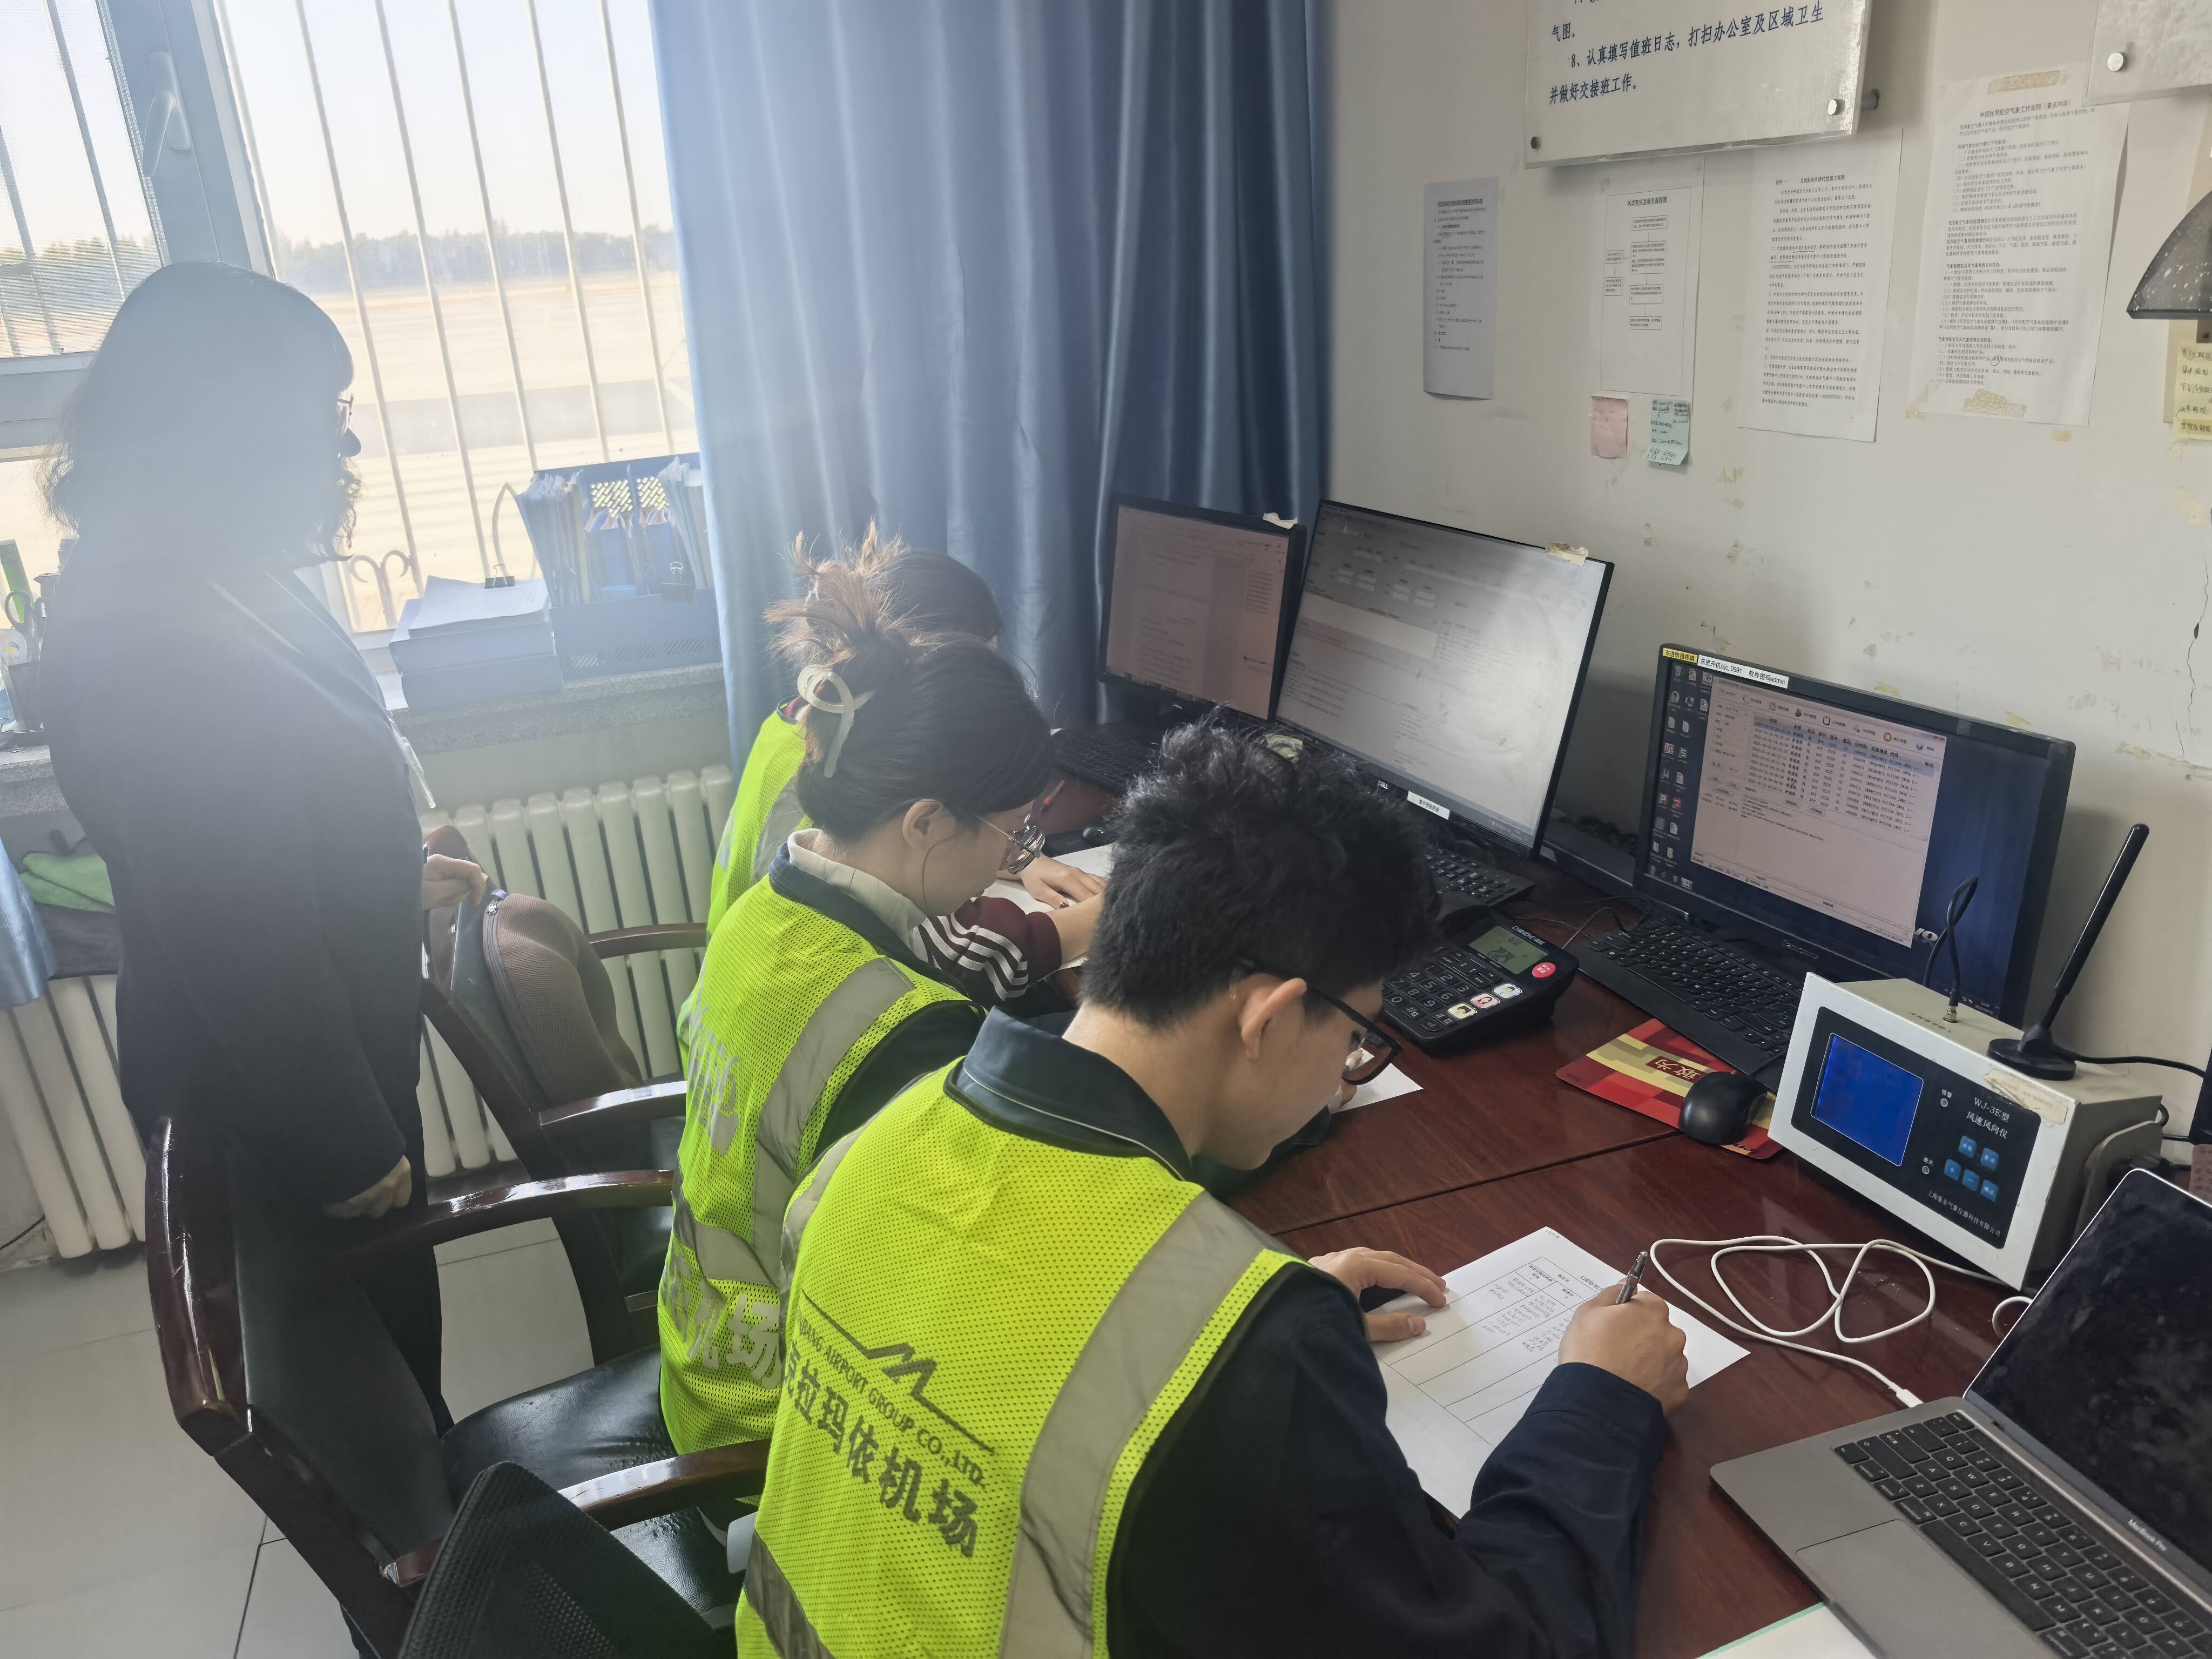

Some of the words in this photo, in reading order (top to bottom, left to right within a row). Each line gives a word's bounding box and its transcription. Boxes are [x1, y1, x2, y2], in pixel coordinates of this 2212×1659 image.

[1552, 22, 1576, 42] 气图。
[1549, 73, 1637, 105] 并做好交接班工作。
[1749, 670, 1786, 686] 软件密码admin
[1654, 1059, 1701, 1080] 敢为
[1974, 1097, 2010, 1123] WJ-3E型
[1966, 1111, 2008, 1139] 风速风向仪
[824, 1348, 867, 1394] AIRPORT
[868, 1387, 915, 1434] GROUP
